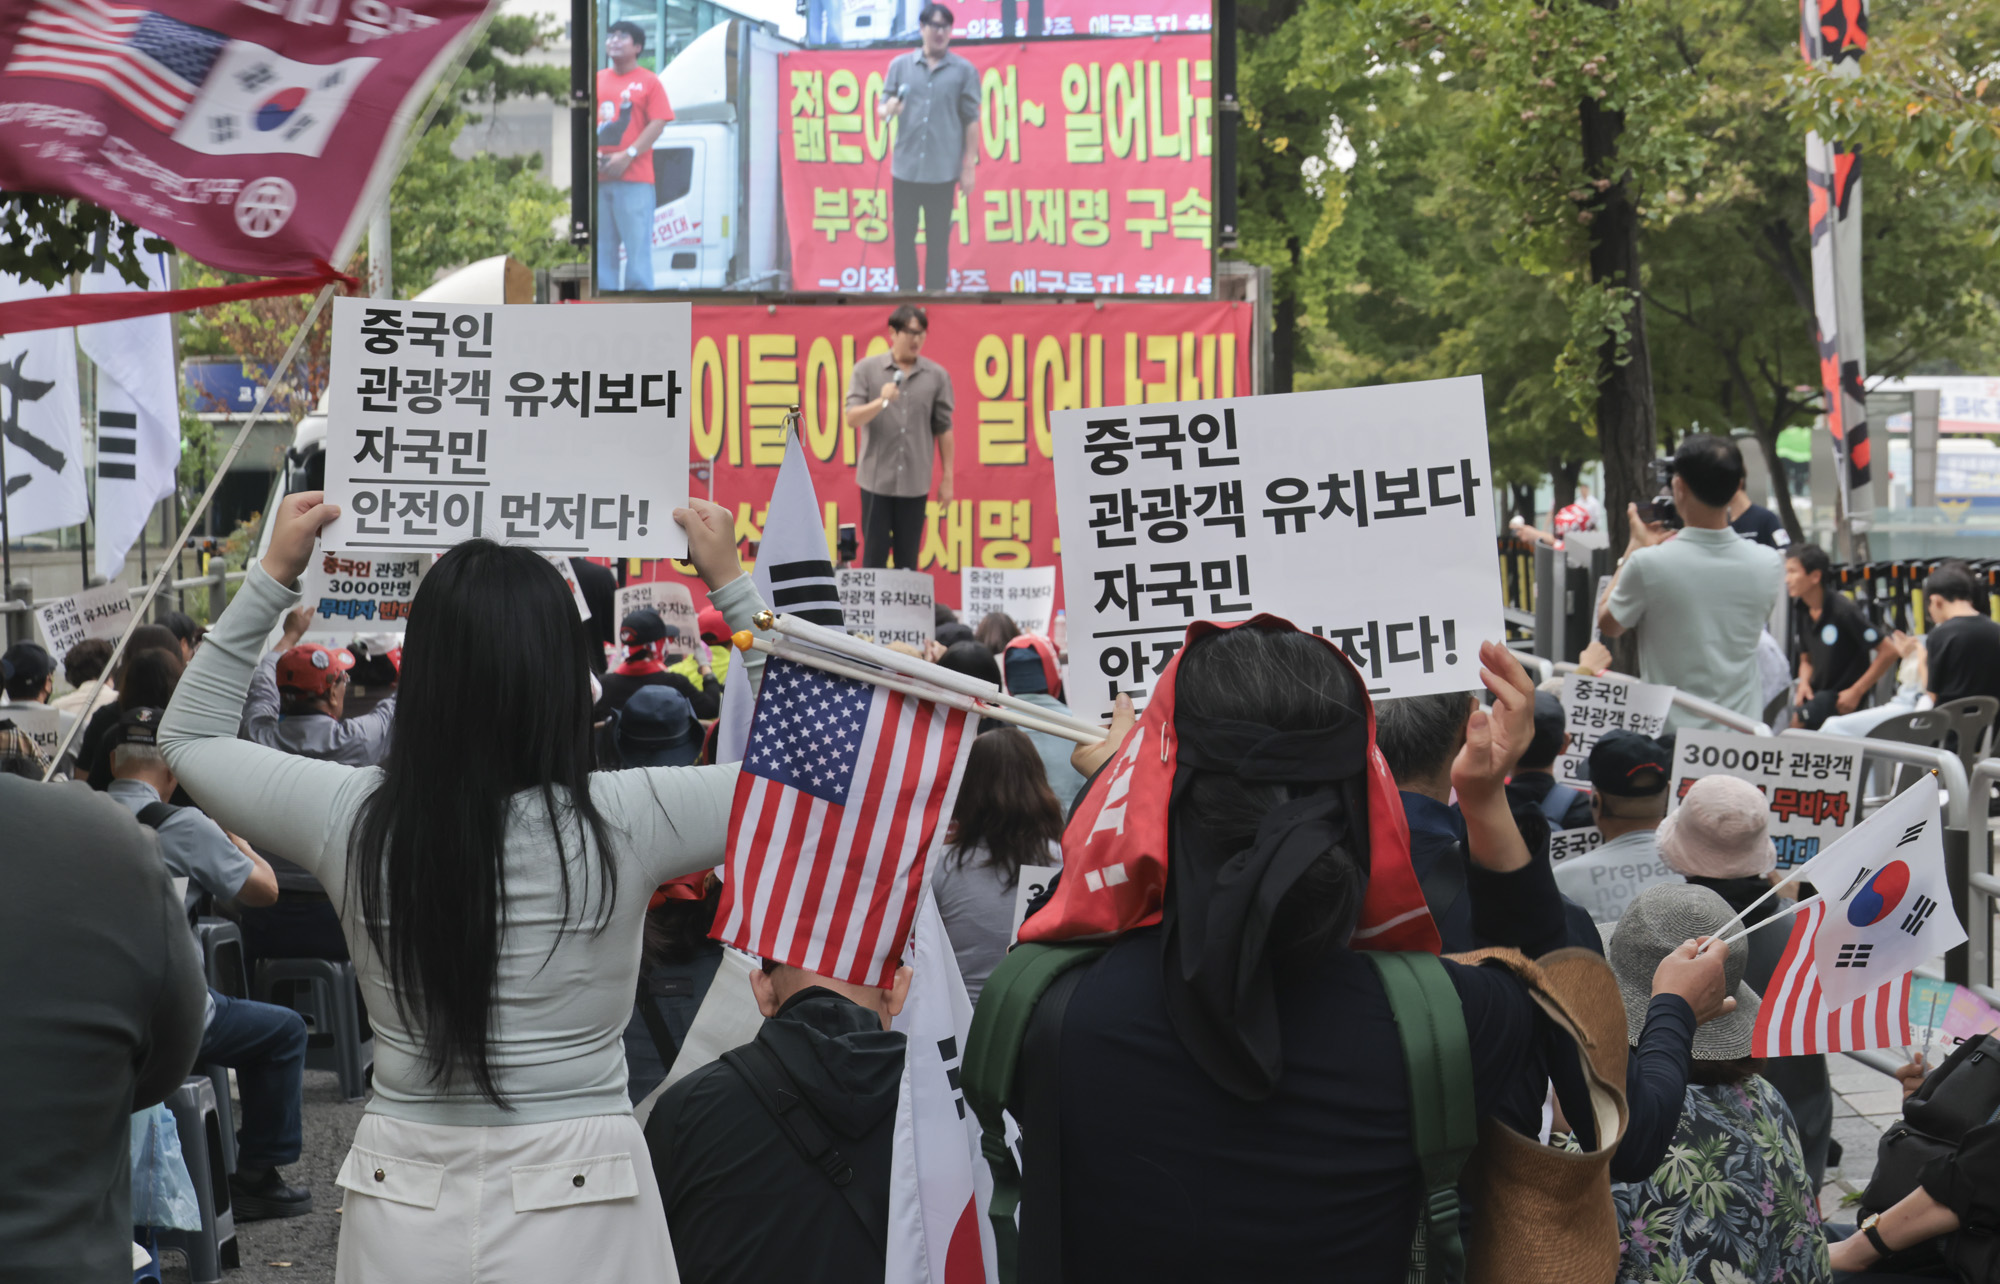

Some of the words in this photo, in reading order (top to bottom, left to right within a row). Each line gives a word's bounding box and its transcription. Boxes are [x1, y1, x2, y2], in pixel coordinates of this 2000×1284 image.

[984, 188, 1110, 247] 리재명
[360, 308, 494, 359] 중국인
[357, 366, 492, 417] 관광객
[504, 370, 683, 419] 유치보다
[353, 426, 488, 476] 자국민
[1084, 408, 1240, 475] 중국인
[351, 488, 484, 538] 안전이
[500, 492, 649, 541] 먼저다!
[1088, 480, 1247, 548] 관광객
[1262, 458, 1481, 535] 유치보다
[322, 555, 372, 578] 중국인
[374, 559, 420, 579] 관광객
[841, 571, 876, 588] 중국인
[328, 579, 412, 598] 3000만명
[880, 590, 932, 609] 유치보다
[1093, 554, 1253, 622] 자국민
[317, 597, 378, 621] 무비자
[1574, 679, 1629, 706] 중국인
[1570, 705, 1626, 729] 관광객
[1683, 744, 1784, 776] 3000만
[1788, 752, 1853, 782] 관광객
[1769, 787, 1851, 828] 무비자
[1589, 860, 1677, 886] Prepa
